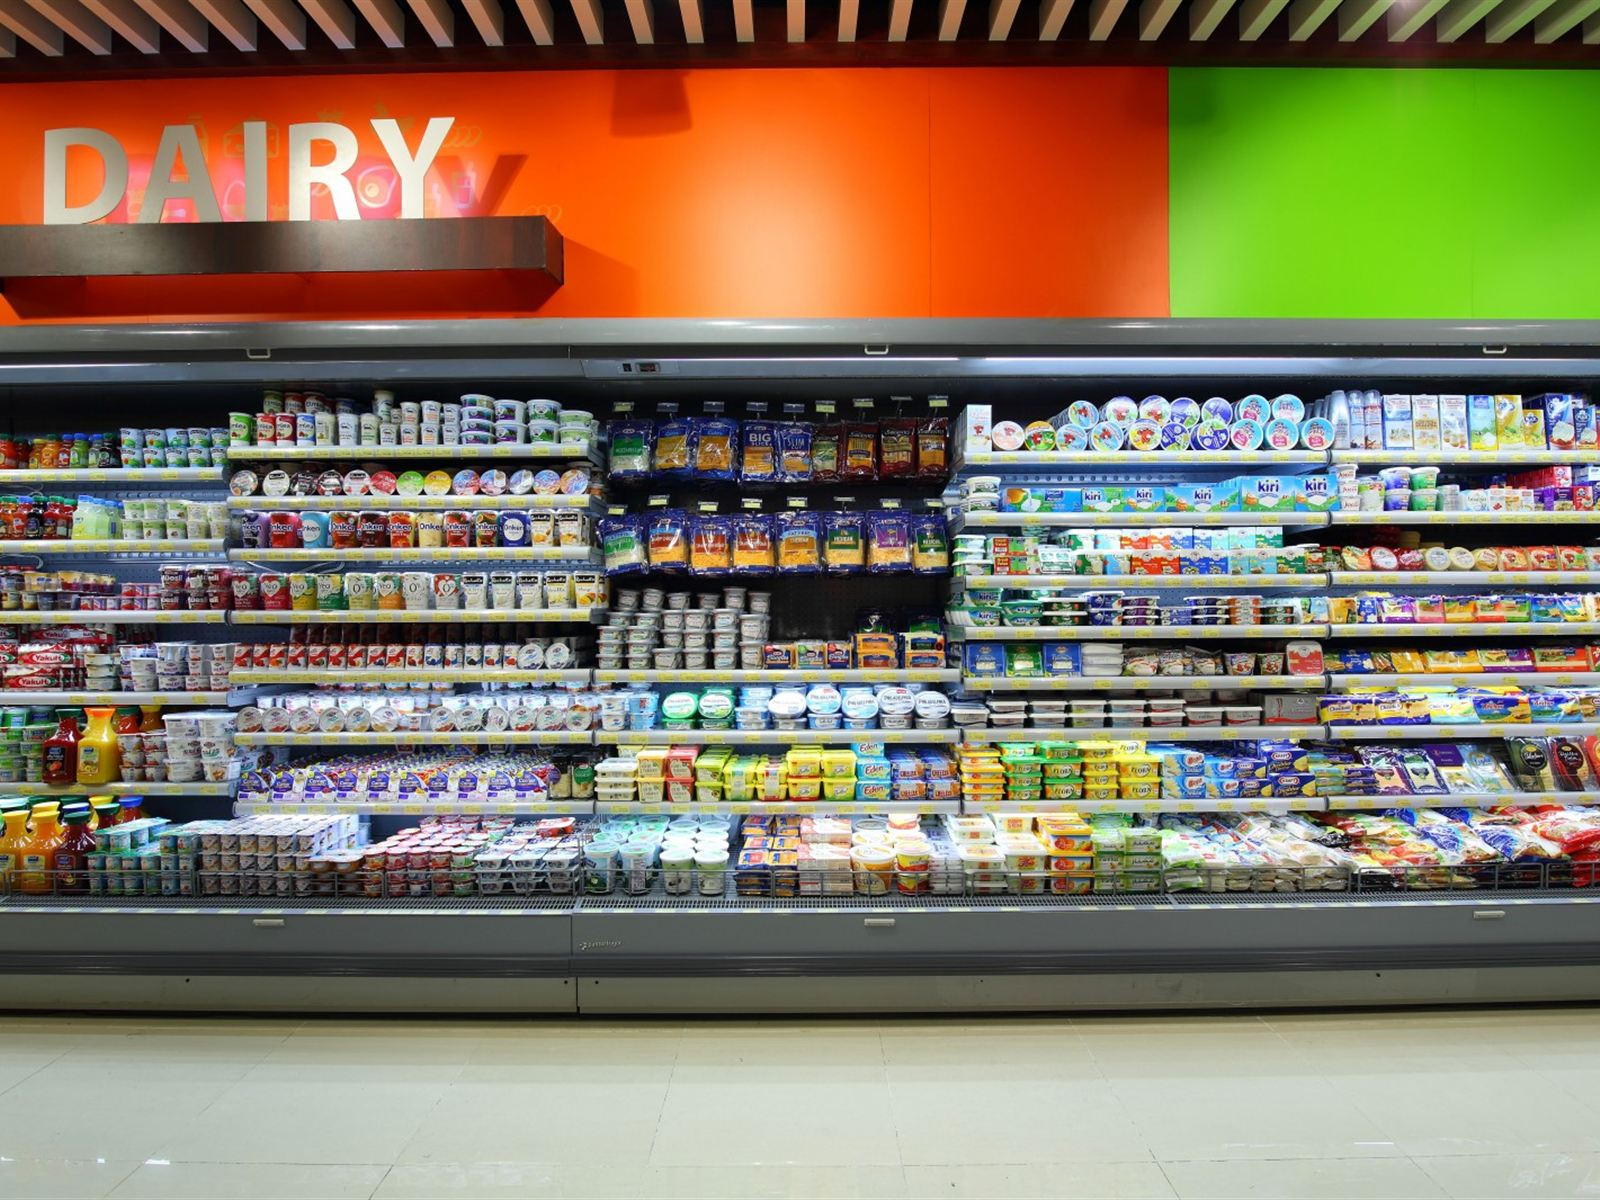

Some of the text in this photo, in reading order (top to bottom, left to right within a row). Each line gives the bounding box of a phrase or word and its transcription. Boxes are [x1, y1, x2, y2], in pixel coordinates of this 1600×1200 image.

[44, 117, 456, 224] DAIRY
[749, 433, 771, 442] BIG
[1257, 479, 1279, 492] kiri
[1305, 478, 1327, 492] kiri
[1084, 490, 1102, 500] kiri
[1194, 489, 1212, 500] kiri
[36, 654, 62, 662] Yakult
[22, 677, 48, 685] Yakult
[866, 765, 884, 774] Eden
[864, 786, 884, 795] Eden
